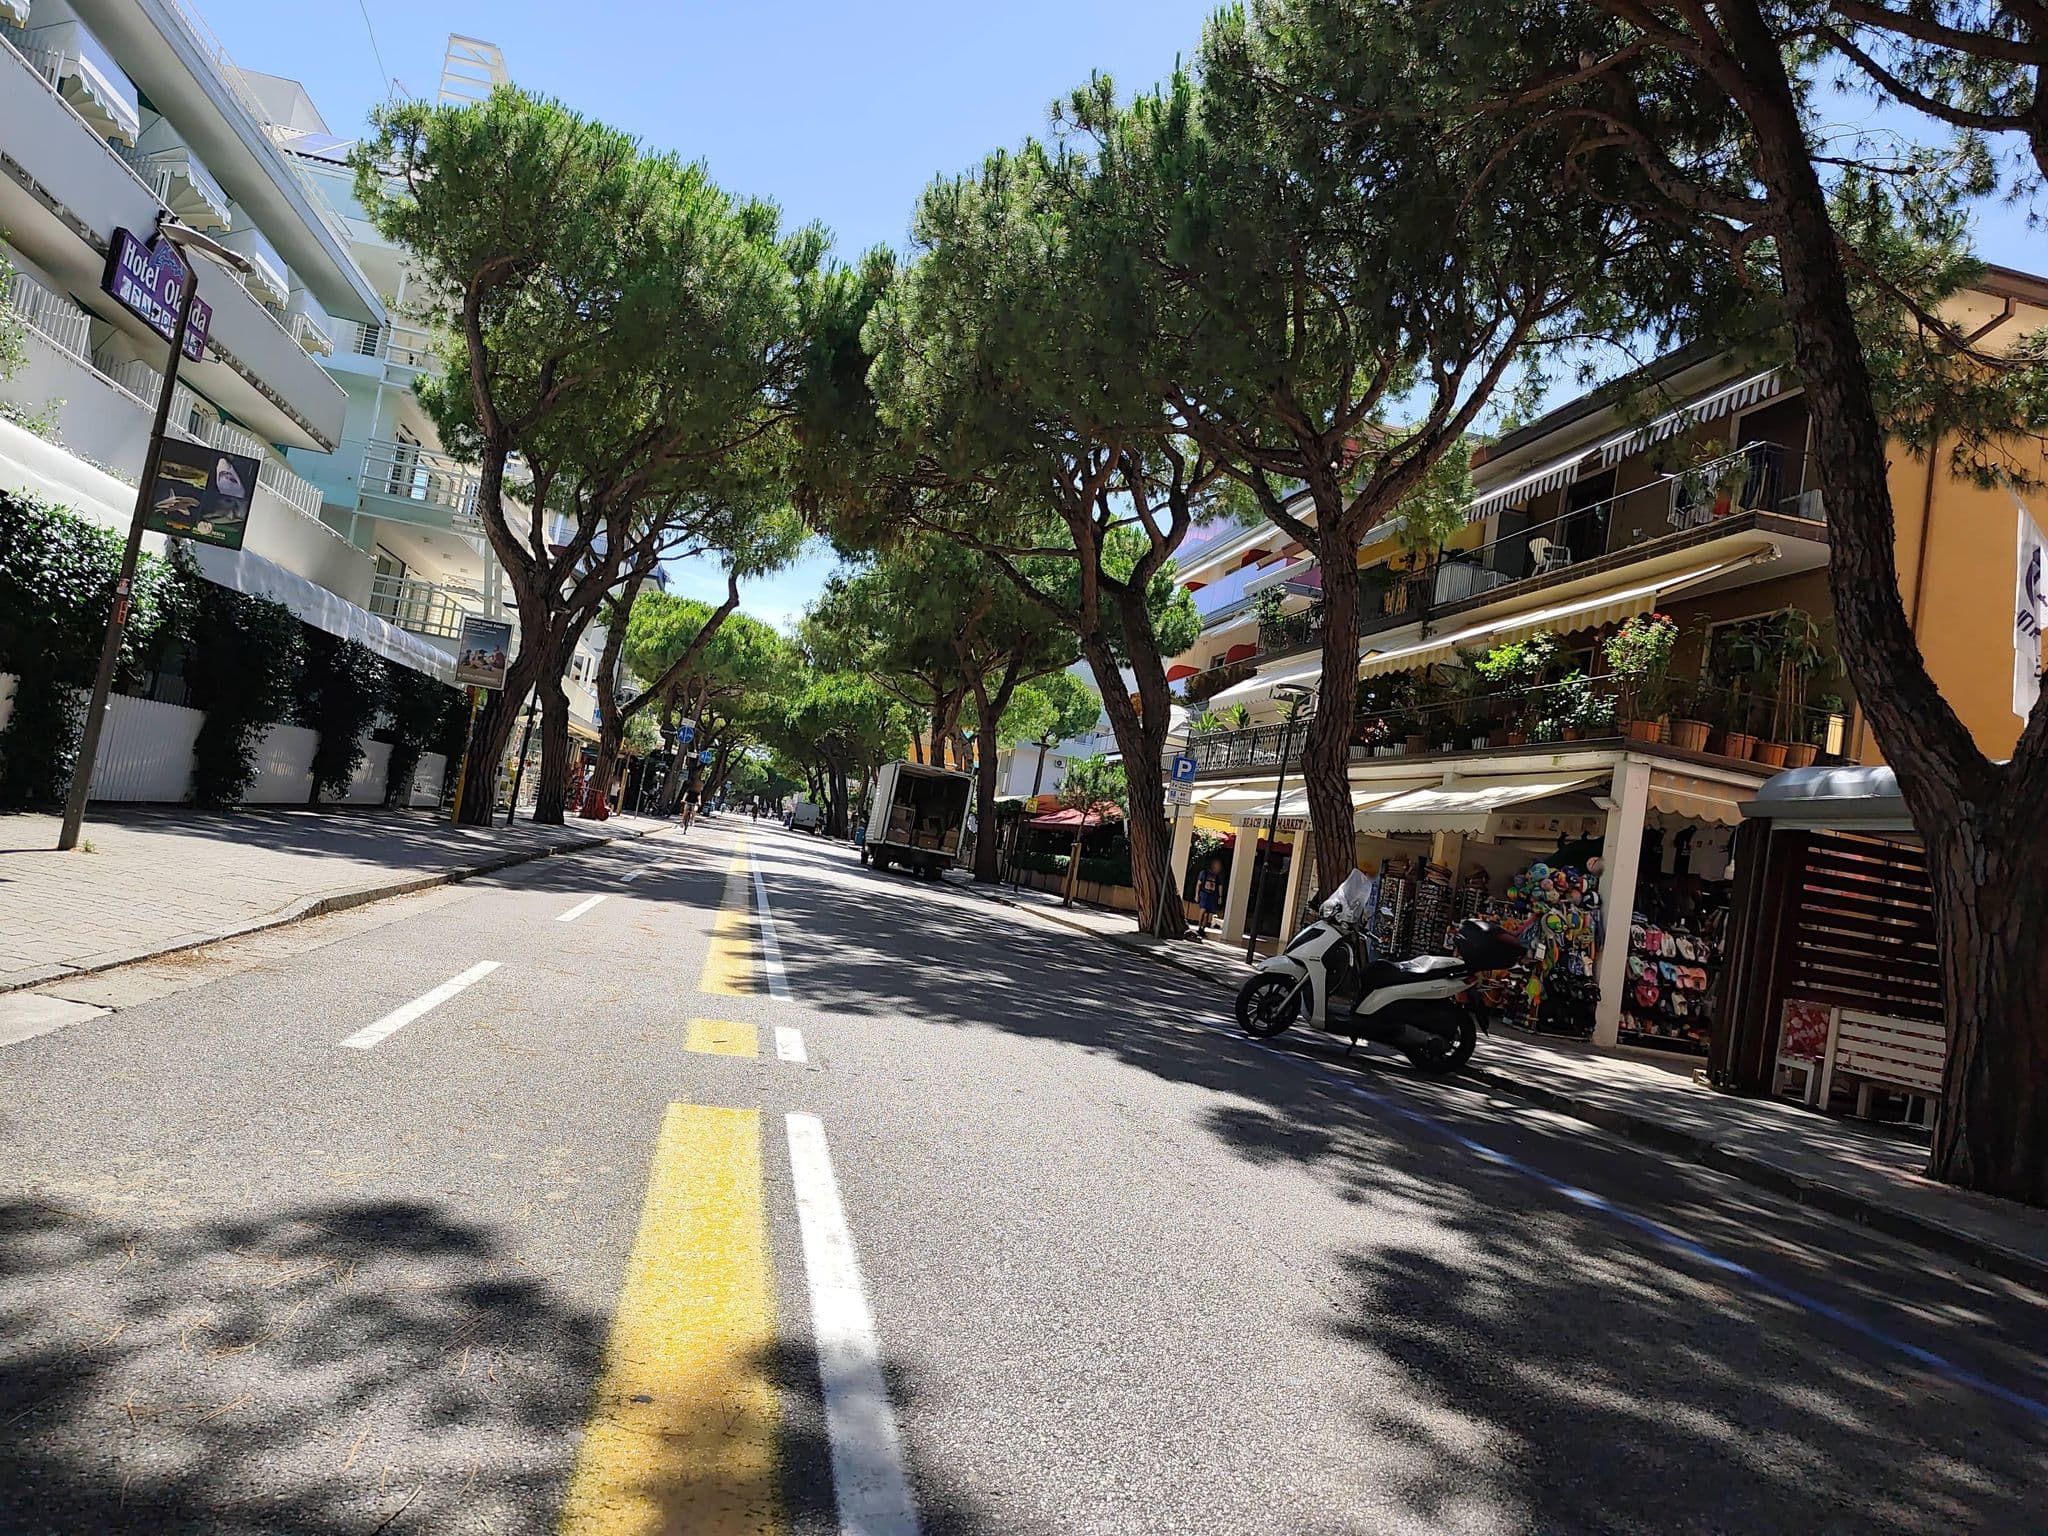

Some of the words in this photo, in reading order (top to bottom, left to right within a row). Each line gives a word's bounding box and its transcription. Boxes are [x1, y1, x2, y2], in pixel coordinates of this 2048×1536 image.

[123, 238, 160, 292] Hotel
[1177, 760, 1192, 778] P
[1243, 817, 1262, 828] BEACH
[1277, 818, 1304, 830] MARKET
